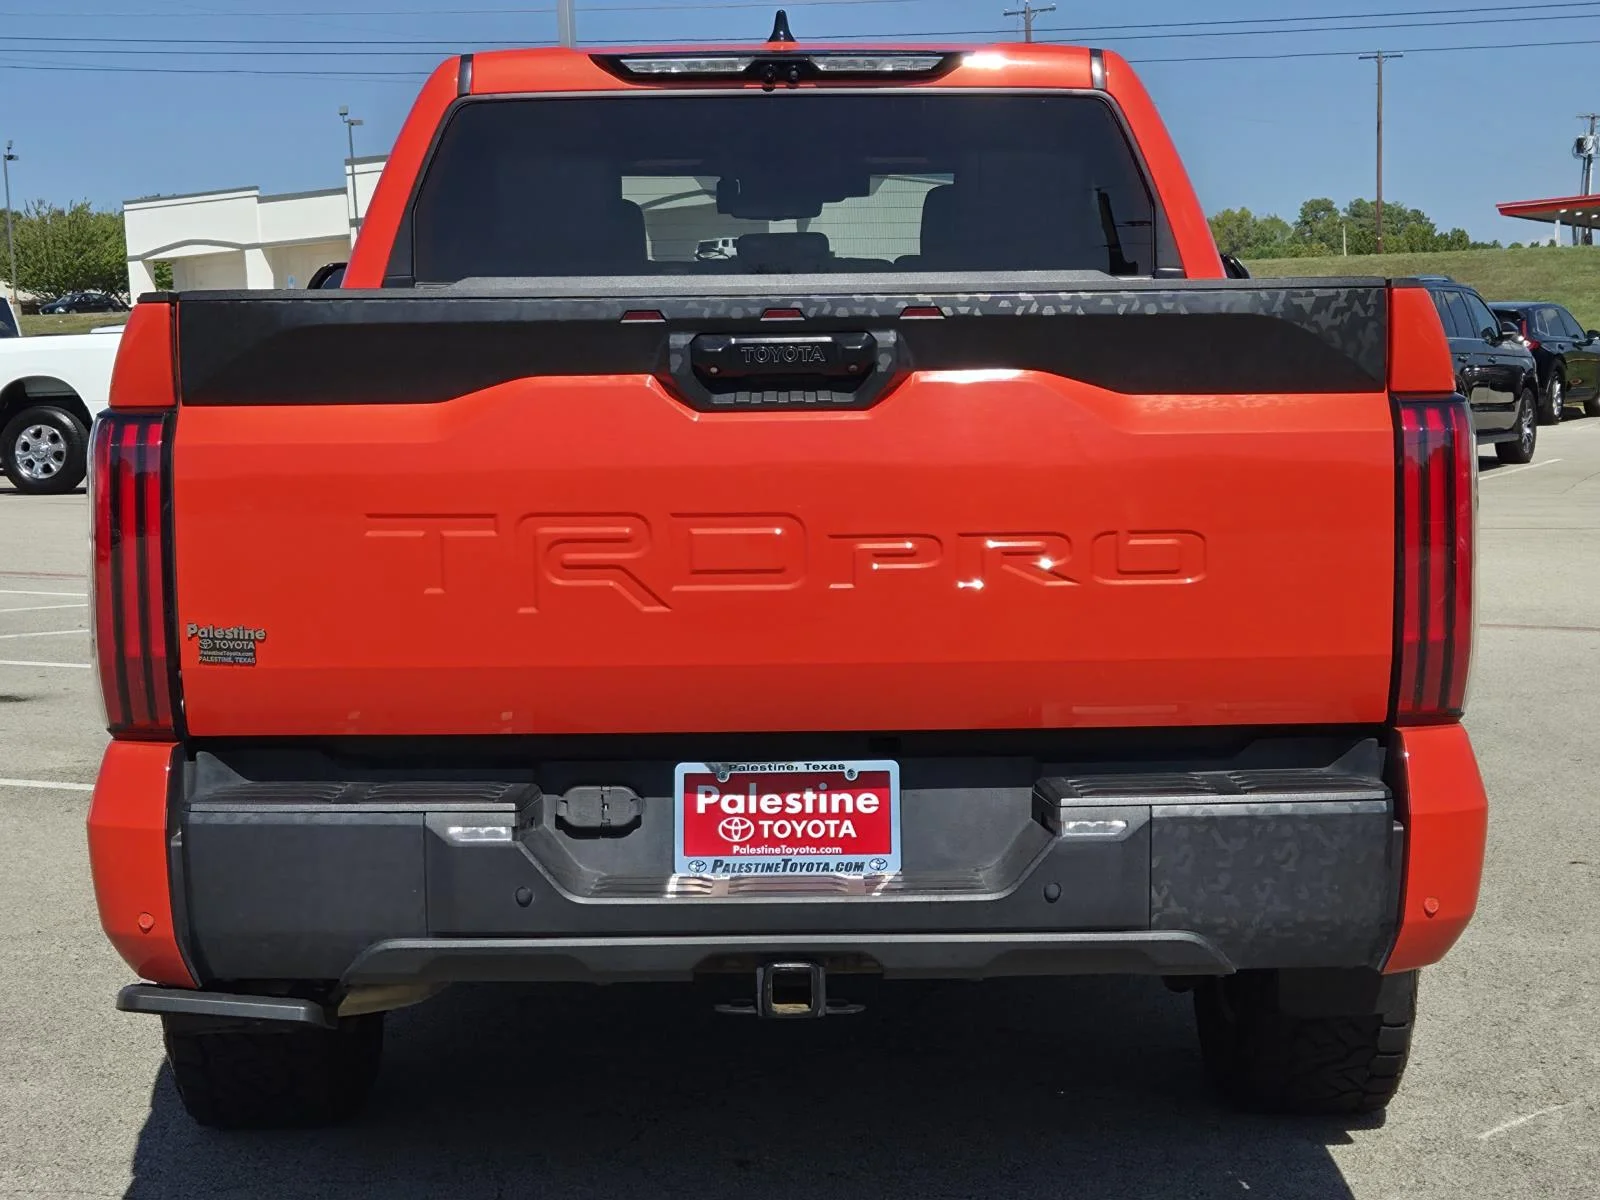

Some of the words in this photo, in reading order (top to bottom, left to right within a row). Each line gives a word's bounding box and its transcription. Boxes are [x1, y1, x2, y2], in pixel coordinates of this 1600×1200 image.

[740, 345, 826, 363] TOYOTA
[364, 512, 809, 614] TRD
[827, 529, 1208, 589] PRO
[186, 623, 267, 641] Palestine
[214, 640, 256, 650] TOYOTA
[728, 763, 799, 772] Palestine,
[804, 763, 846, 771] Texas
[696, 782, 880, 815] Palestine
[758, 819, 858, 839] TOYOTA
[732, 845, 843, 856] PalestineToyota.com
